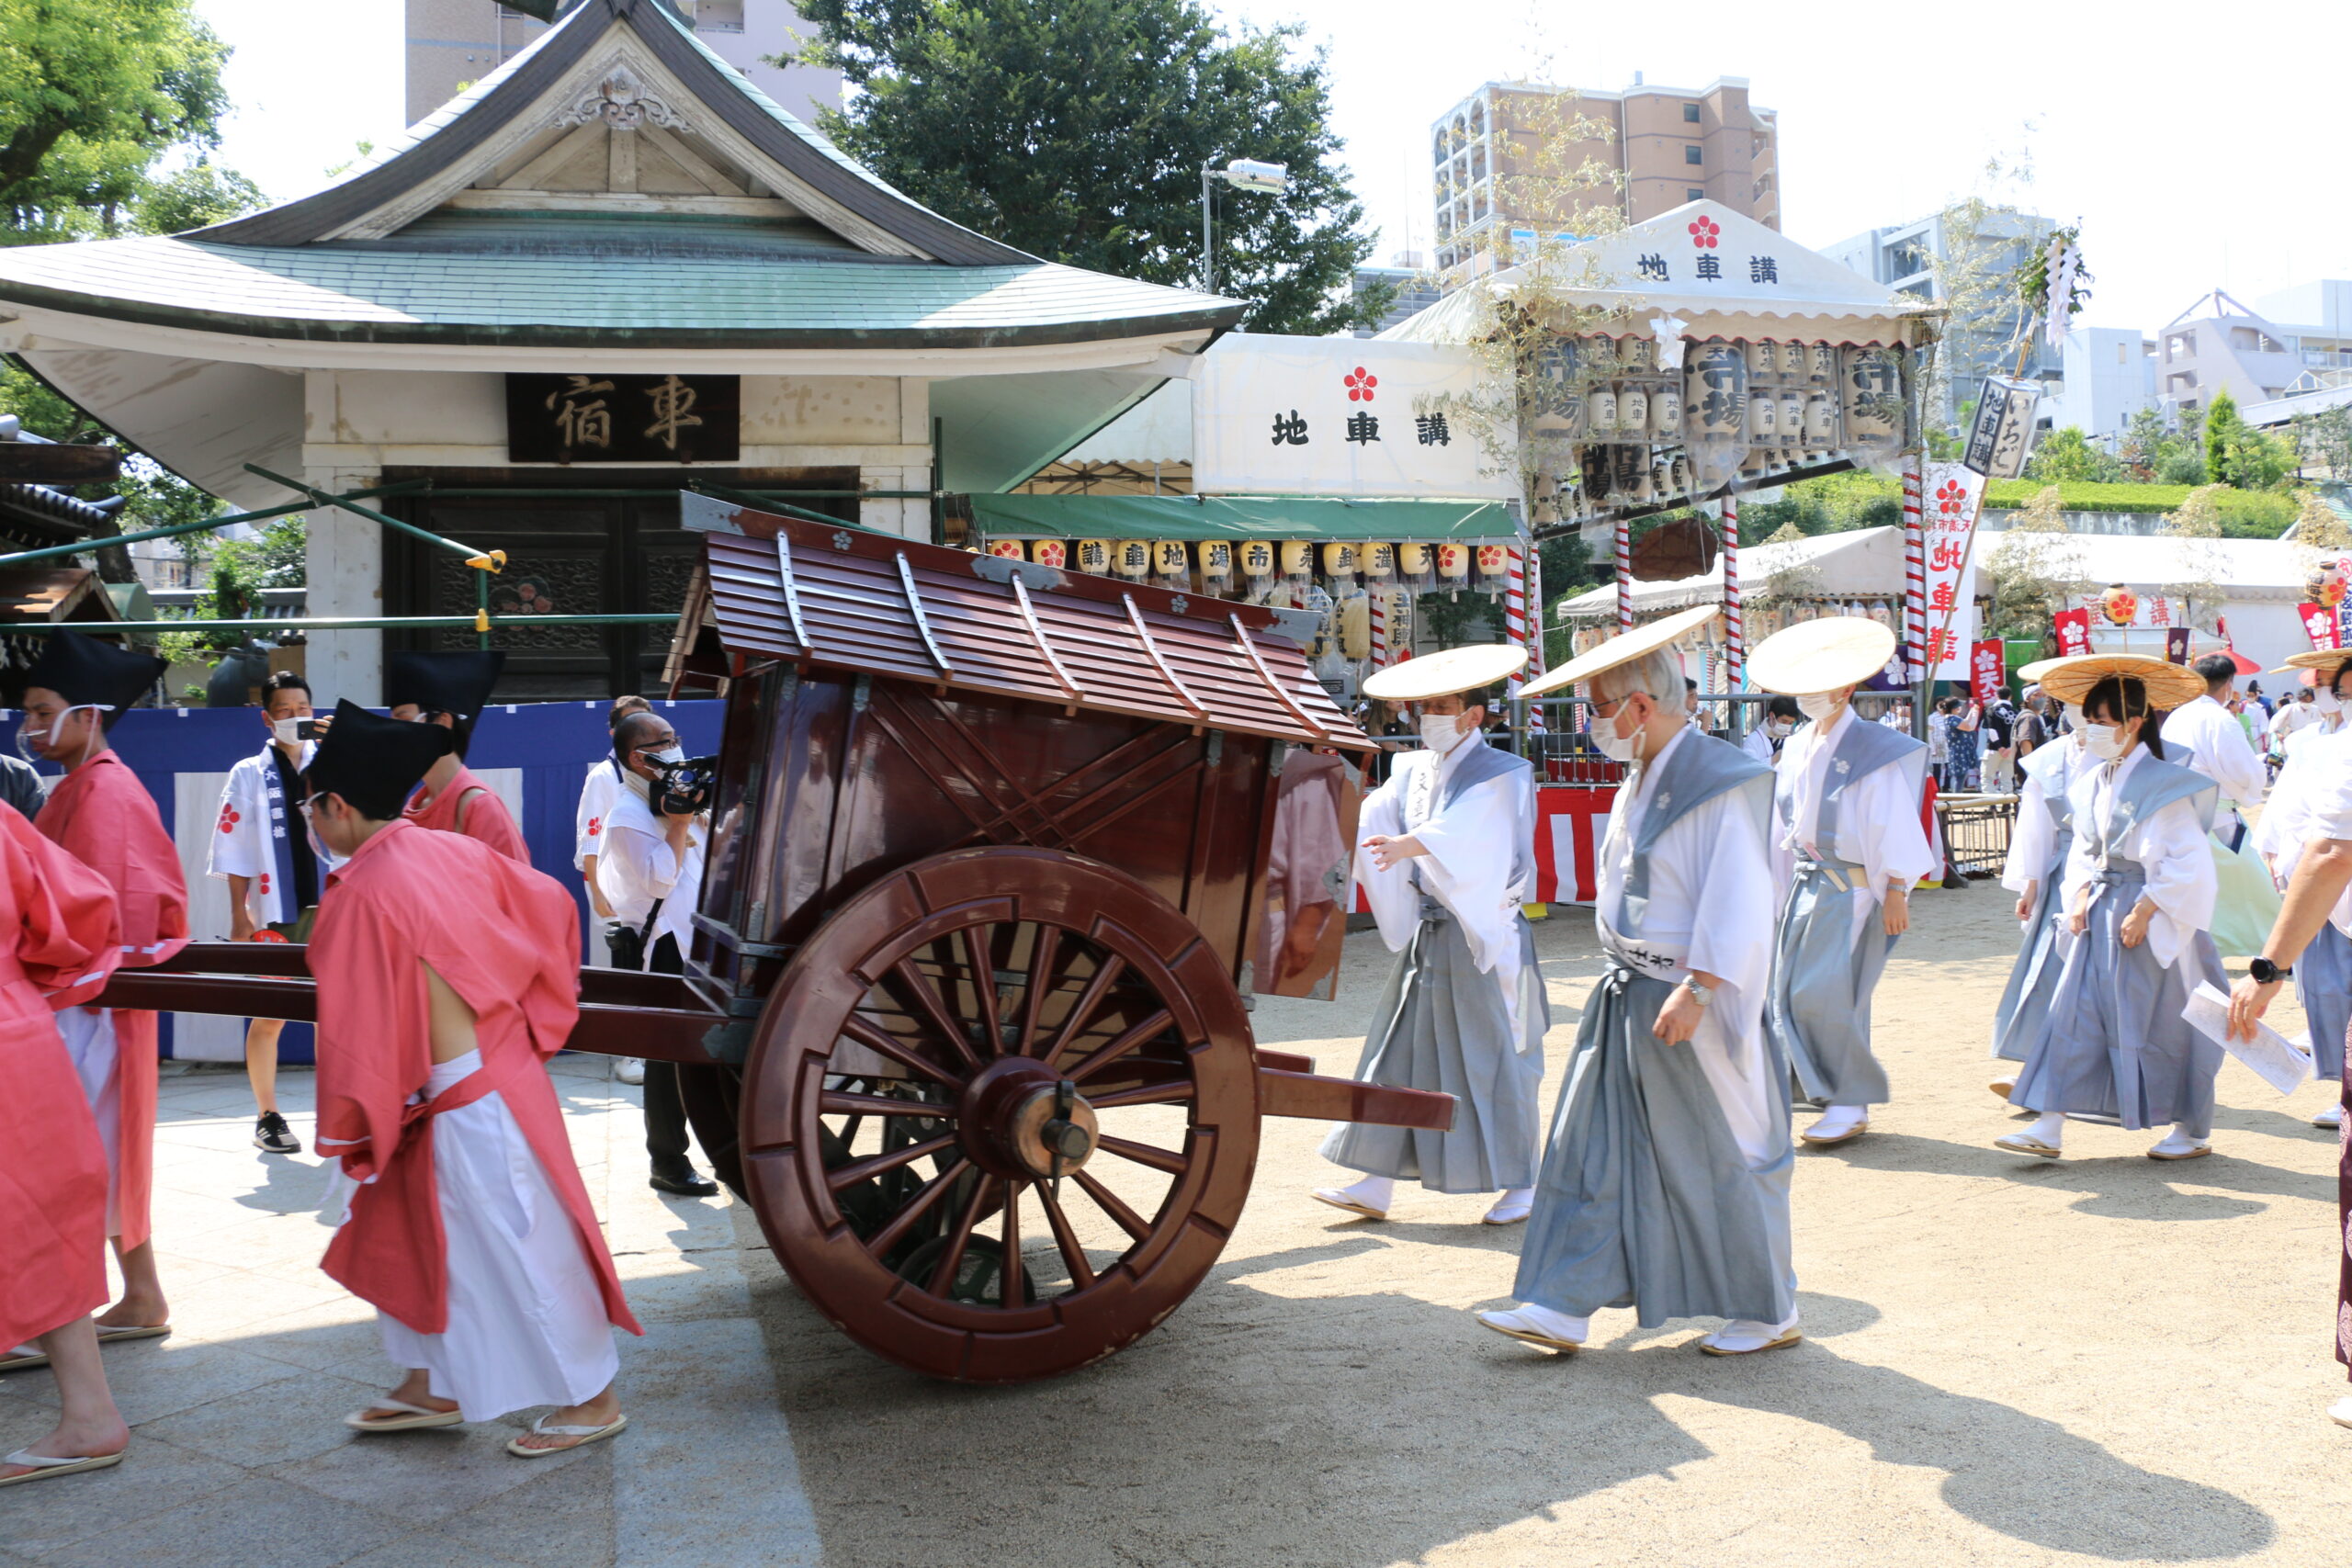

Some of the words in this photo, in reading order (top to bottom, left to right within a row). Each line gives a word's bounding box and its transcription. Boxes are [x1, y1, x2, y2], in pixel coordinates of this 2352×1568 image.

[1636, 253, 1779, 284] 地車講
[1272, 409, 1452, 447] 地車講
